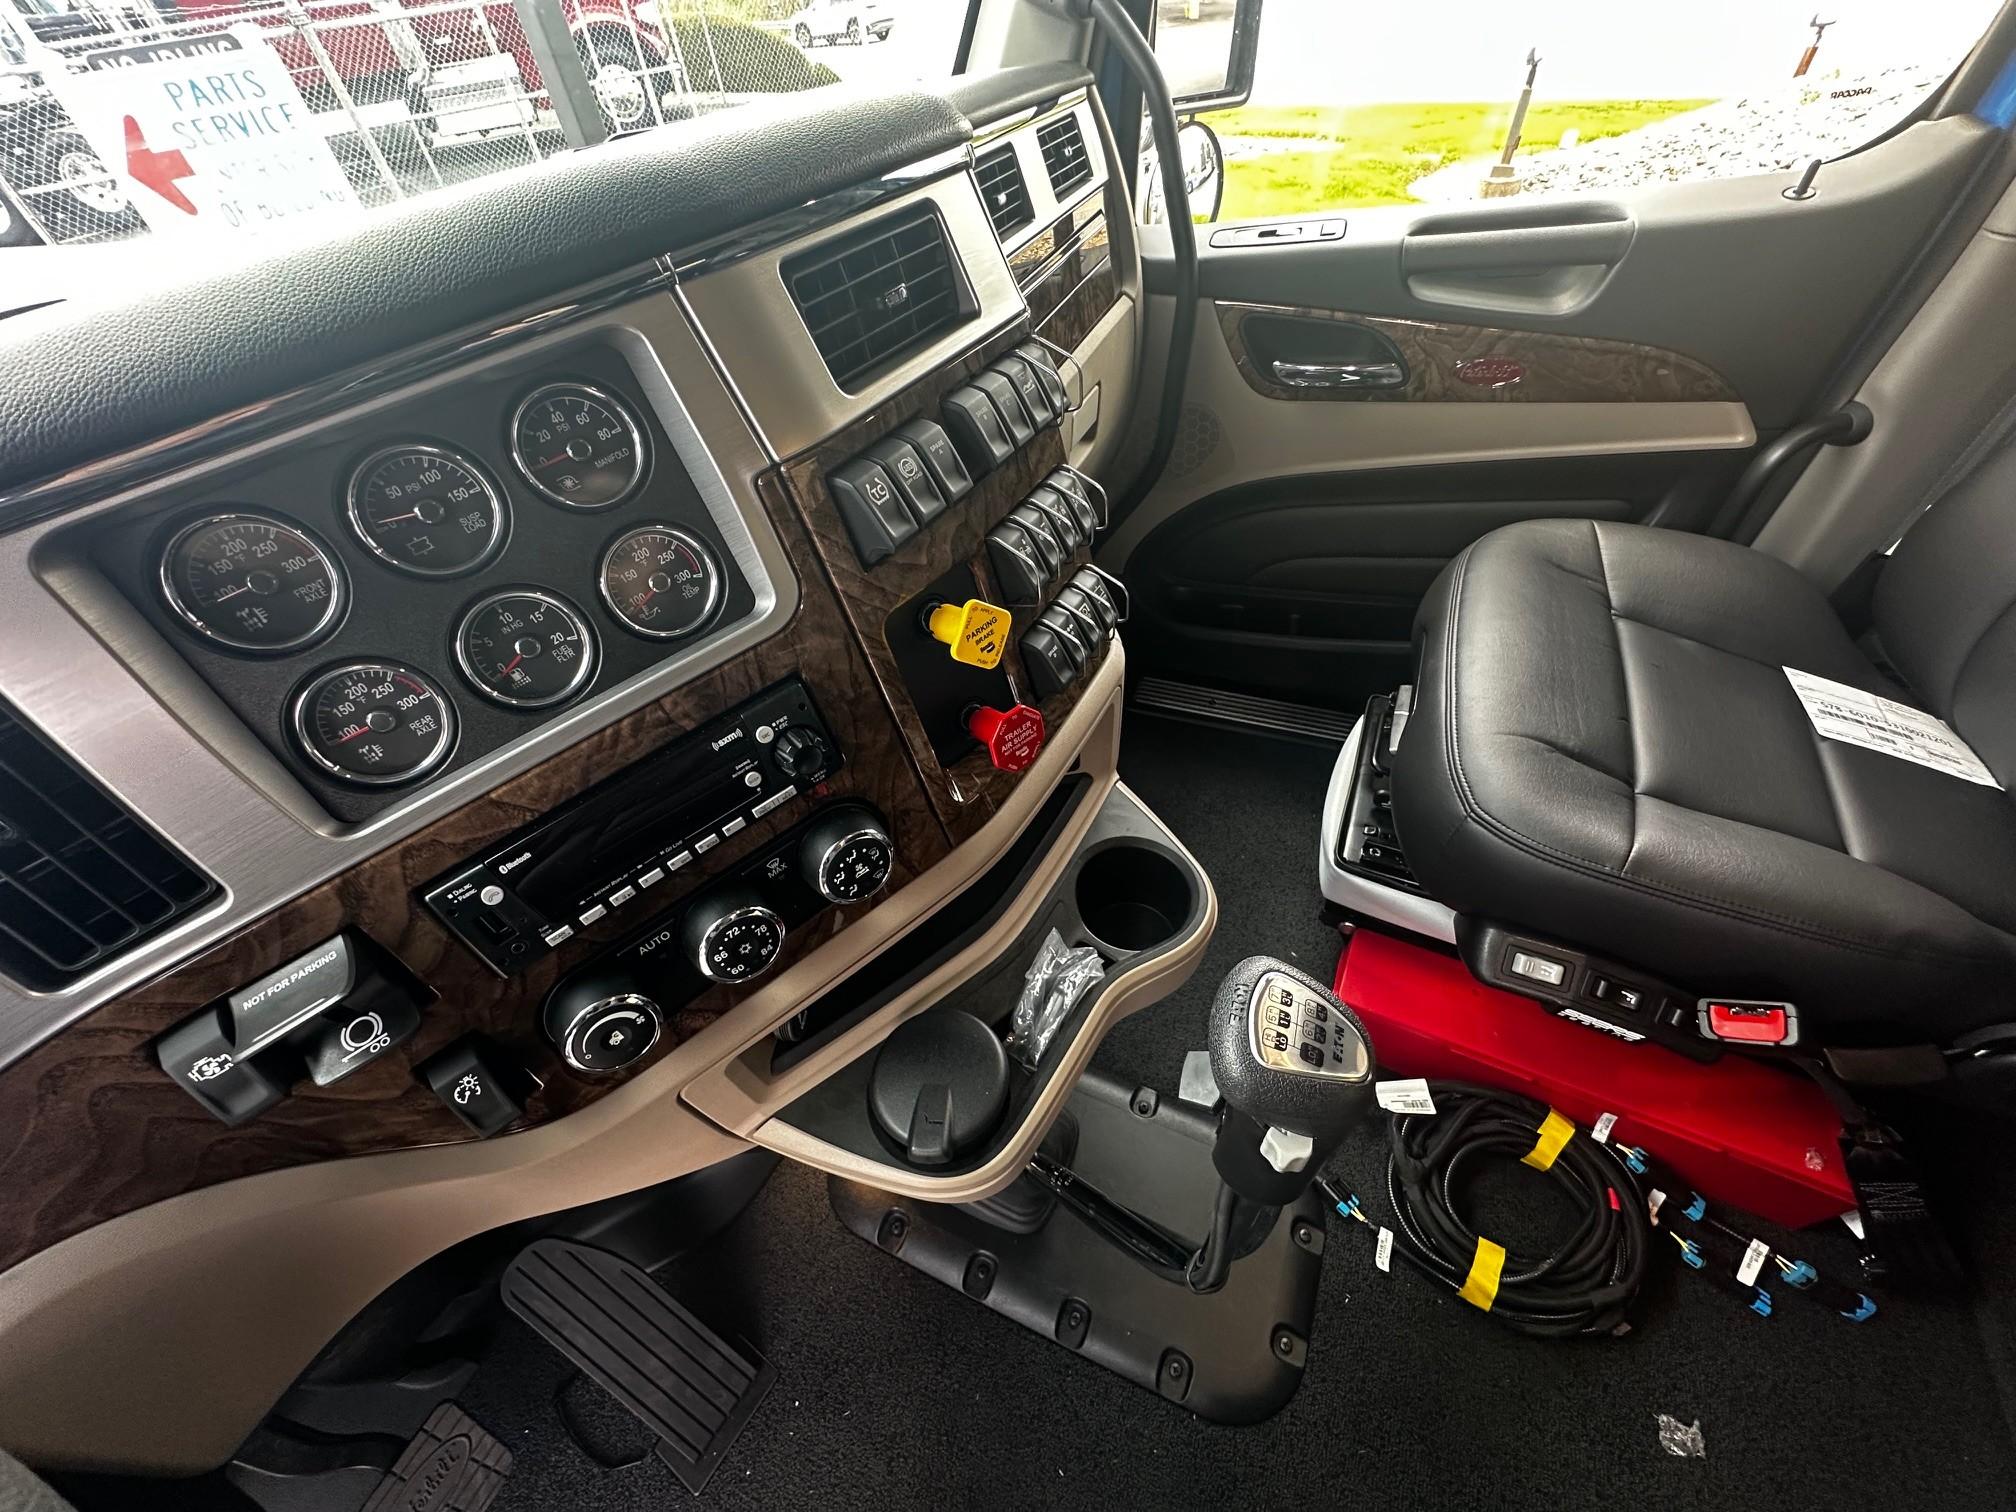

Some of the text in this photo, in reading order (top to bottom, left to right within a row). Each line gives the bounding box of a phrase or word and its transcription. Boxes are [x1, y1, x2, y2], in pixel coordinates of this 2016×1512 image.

[163, 69, 267, 112] PARTS
[172, 102, 297, 151] SERVICE
[551, 411, 590, 425] 40 60
[536, 427, 612, 443] 20 80
[556, 422, 571, 432] PSI
[594, 447, 630, 468] MANIFOLD
[420, 469, 442, 485] 100
[385, 485, 469, 503] 50 150
[405, 482, 422, 495] PSI
[871, 484, 886, 499] TC
[463, 519, 487, 534] LOAD
[221, 538, 278, 558] 200 250
[632, 547, 675, 565] 200 250
[208, 559, 233, 576] 150
[281, 556, 306, 574] 300
[620, 569, 691, 584] 150 300
[293, 579, 327, 598] FRONT
[304, 588, 329, 604] AXLE
[629, 592, 646, 606] 100
[499, 611, 544, 625] 10 15
[966, 616, 997, 643] PARKING
[975, 629, 994, 646] BRAKE
[483, 638, 494, 647] 5
[550, 632, 565, 646] 20
[551, 644, 572, 658] FUEL
[345, 682, 395, 700] 200 250
[332, 702, 355, 718] 150
[397, 694, 419, 711] 300
[409, 714, 434, 731] REAR
[415, 722, 438, 737] AXLE
[1005, 721, 1031, 741] TRAILER
[338, 723, 361, 740] 100
[1002, 724, 1038, 753] AIR SUPPLY
[506, 852, 532, 870] Bluetooth
[767, 862, 788, 879] MAX
[726, 924, 768, 939] 72 78
[639, 931, 671, 955] AUTO
[714, 944, 773, 962] 66 84
[731, 964, 745, 975] 60
[242, 950, 337, 1011] NOT FOR PARKING
[1279, 1037, 1287, 1050] LO
